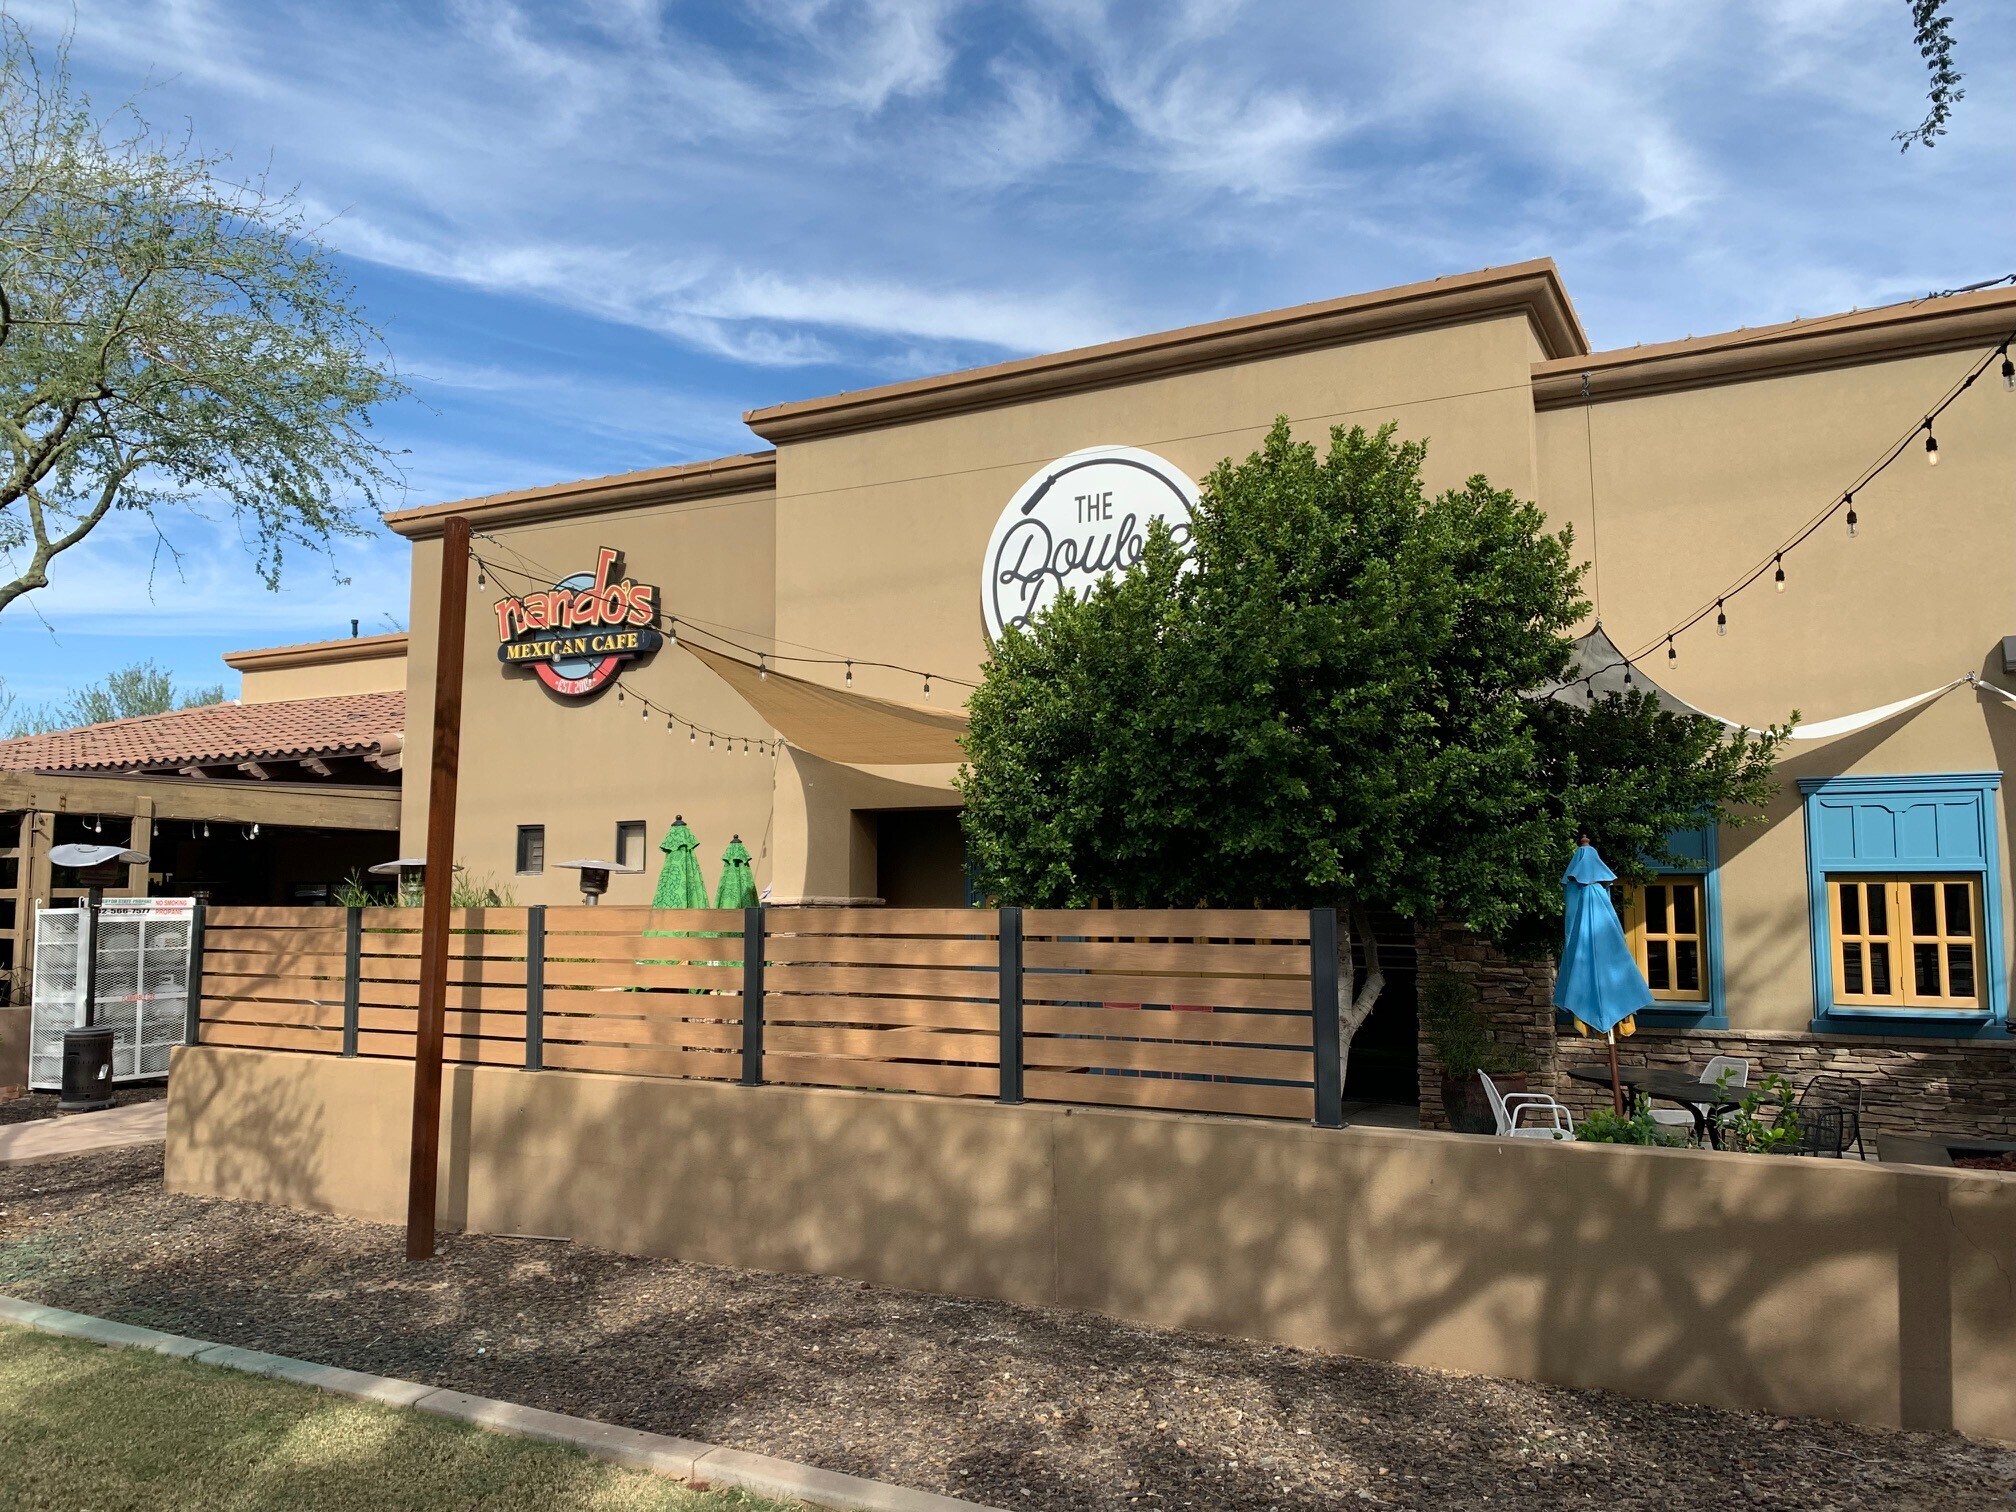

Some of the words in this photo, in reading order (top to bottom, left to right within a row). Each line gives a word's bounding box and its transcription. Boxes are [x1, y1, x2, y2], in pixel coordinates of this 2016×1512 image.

[1074, 491, 1113, 524] THE
[993, 512, 1197, 584] Doube
[494, 546, 656, 643] nando's
[506, 637, 587, 660] MEXICAN
[592, 632, 638, 651] CAFE
